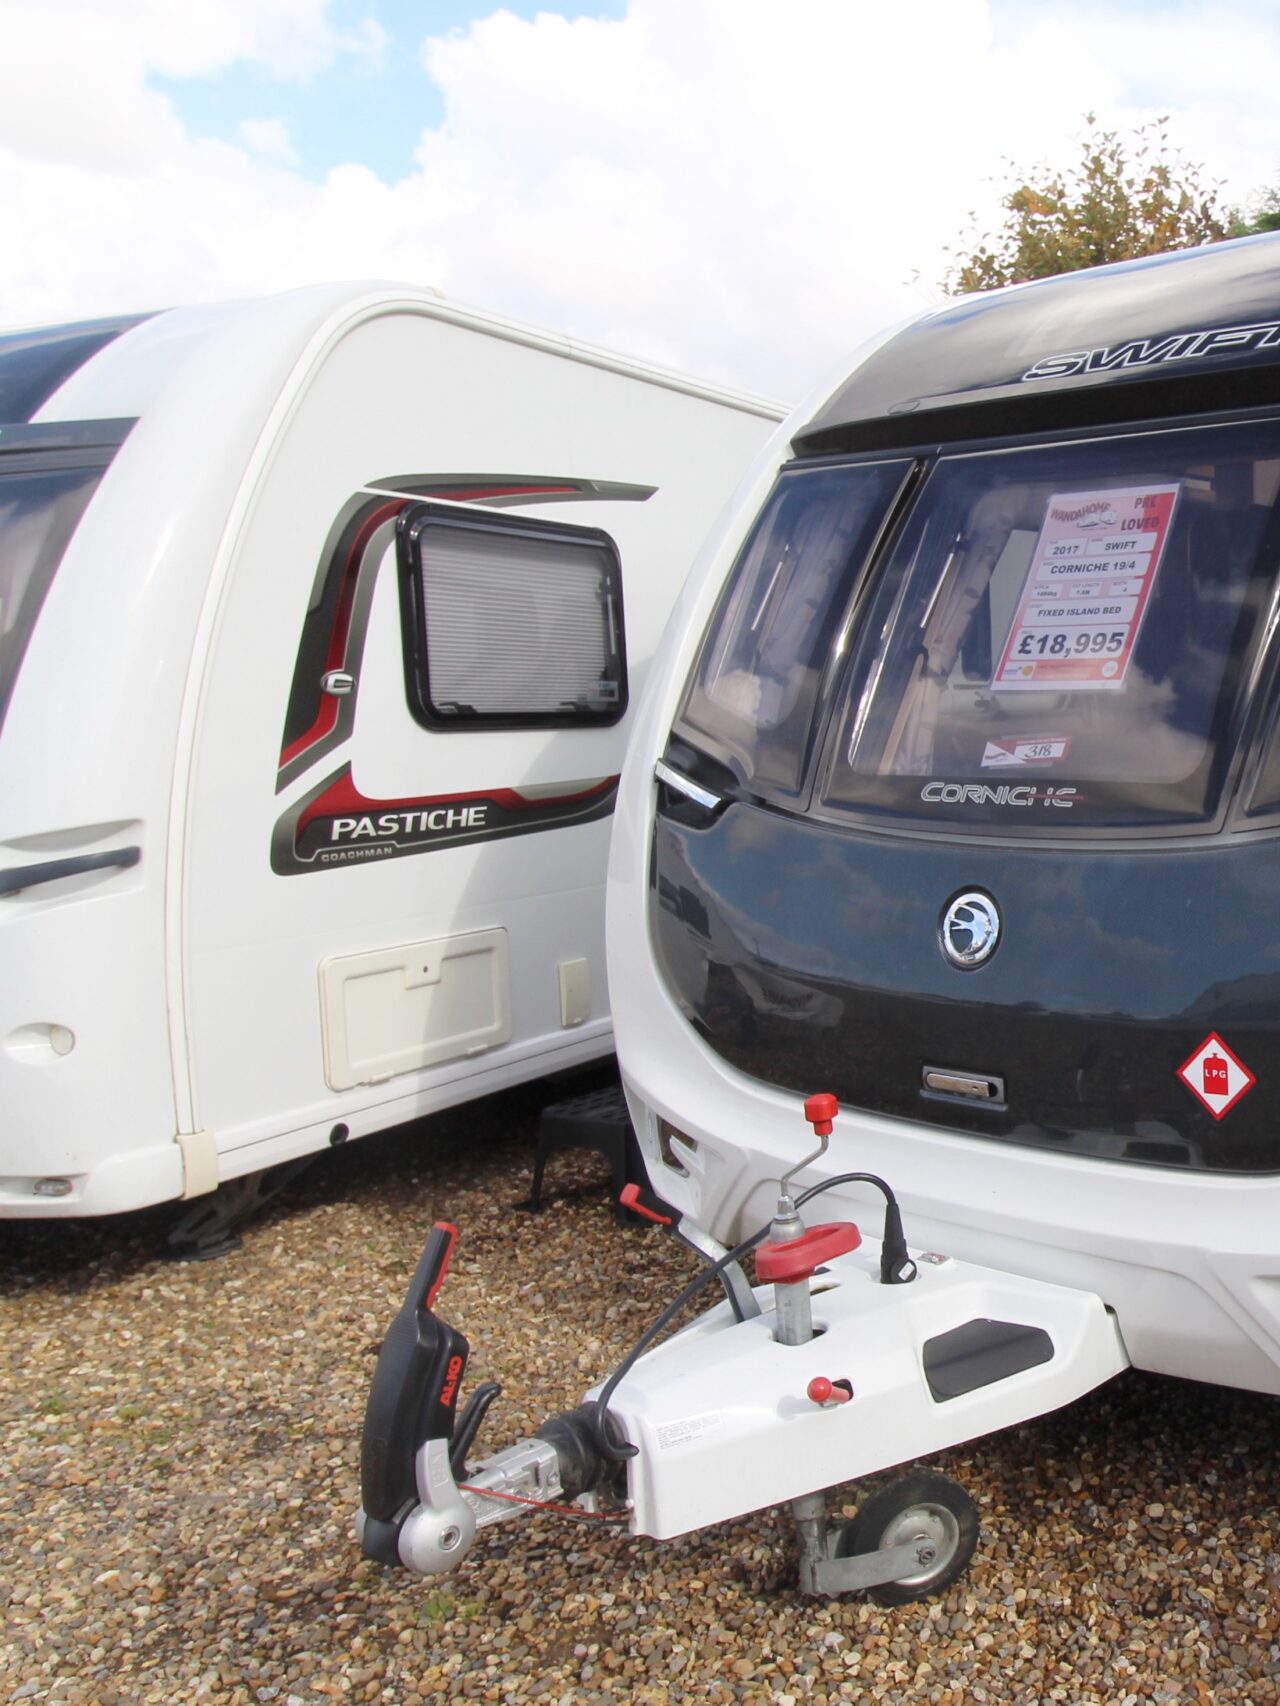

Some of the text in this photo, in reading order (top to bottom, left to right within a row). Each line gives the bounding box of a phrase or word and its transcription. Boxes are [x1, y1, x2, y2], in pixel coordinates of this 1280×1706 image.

[1134, 496, 1157, 509] PRE
[1051, 502, 1111, 522] WANDAHOME
[1121, 517, 1160, 531] LOVED
[1052, 545, 1080, 555] 2017
[1104, 541, 1138, 551] SWIFT
[1050, 562, 1110, 575] CORNICHE
[1037, 606, 1122, 617] FIXED ISLAND BED
[1018, 631, 1125, 658] £18,995
[1024, 744, 1053, 758] 318
[921, 781, 1077, 807] CORNICHE
[330, 806, 488, 841] PASTICHE
[320, 846, 393, 863] COACHMAN
[1204, 1068, 1227, 1079] LPG
[439, 1355, 463, 1408] AL-KO
